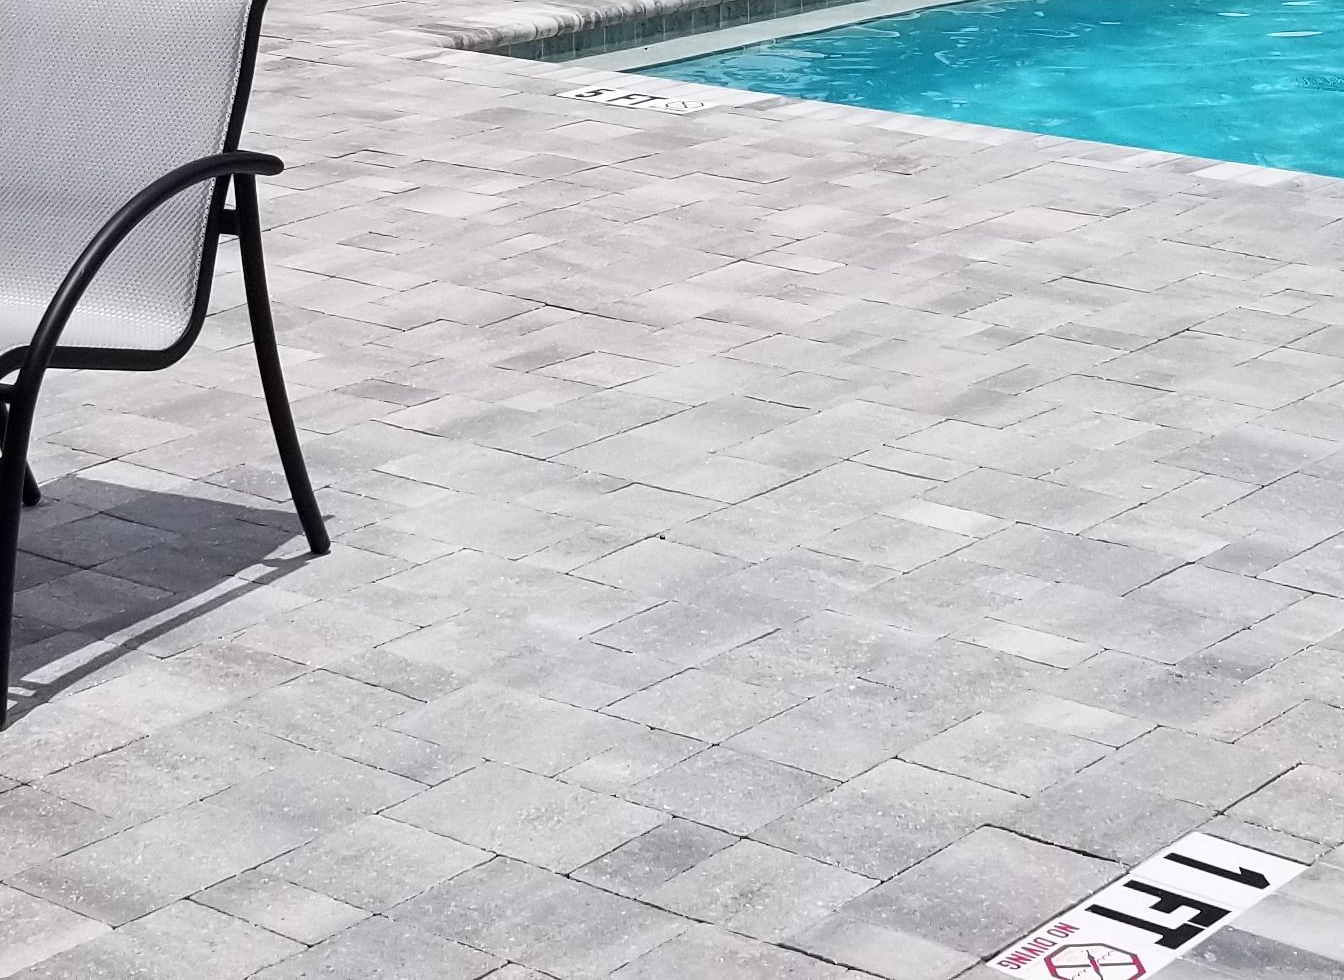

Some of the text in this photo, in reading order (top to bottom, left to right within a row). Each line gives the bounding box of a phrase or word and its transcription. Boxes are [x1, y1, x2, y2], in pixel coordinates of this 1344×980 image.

[575, 88, 670, 106] 5 FT
[1084, 852, 1271, 950] 1 FT
[996, 922, 1081, 970] NO DIVING
